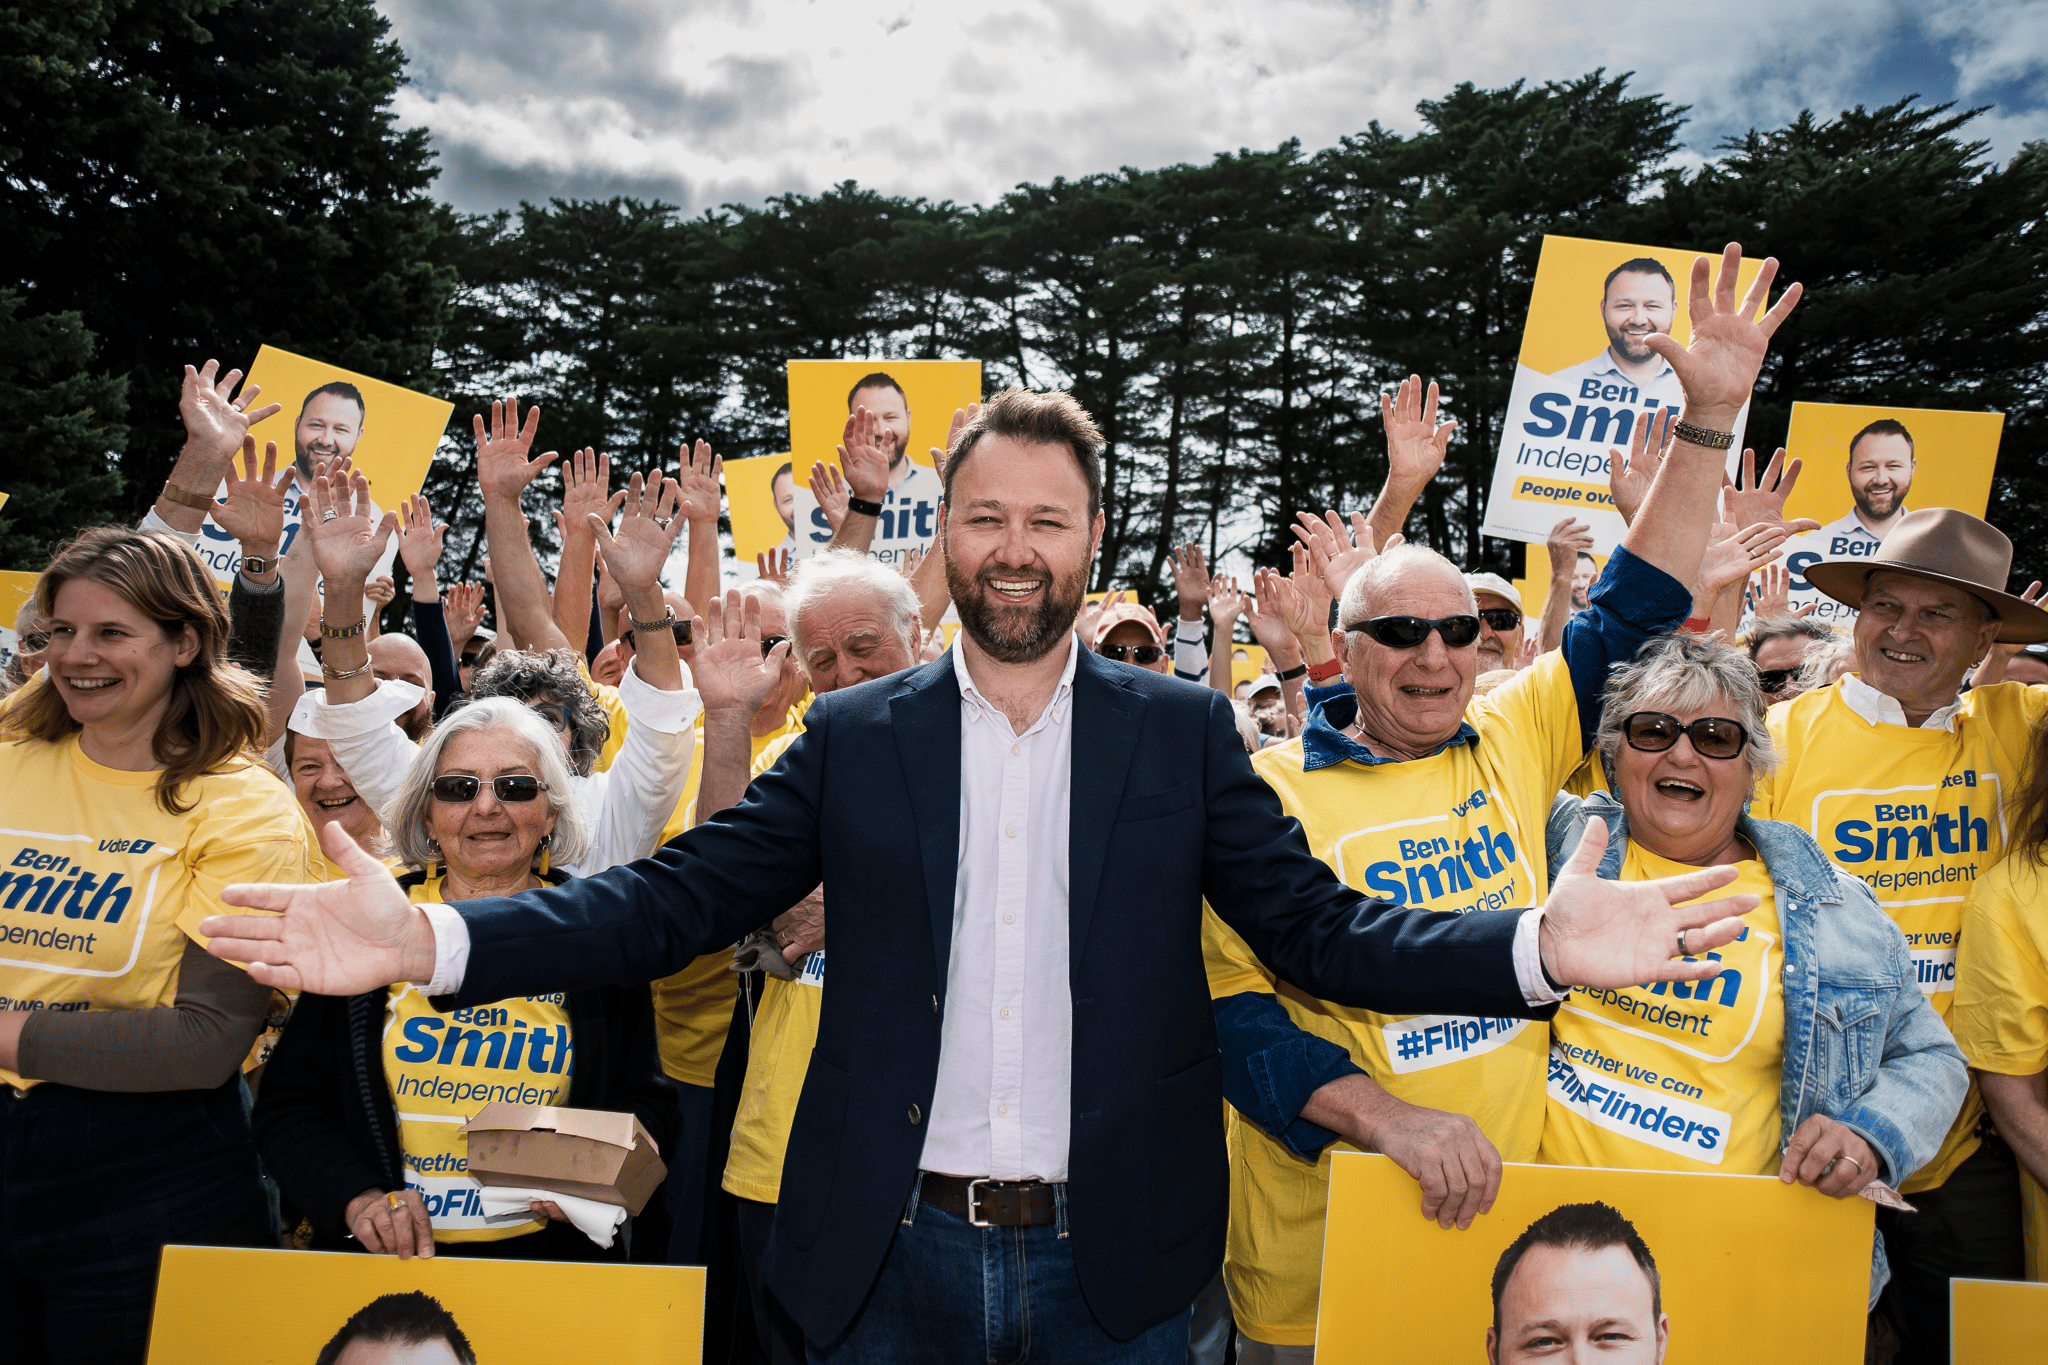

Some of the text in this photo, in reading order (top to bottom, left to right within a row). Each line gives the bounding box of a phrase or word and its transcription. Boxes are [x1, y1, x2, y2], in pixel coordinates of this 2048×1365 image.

[1579, 378, 1639, 404] Ben
[1520, 482, 1616, 506] People ove
[1829, 537, 1881, 557] Ben
[1875, 804, 1928, 822] Ben
[98, 838, 130, 853] Vote
[1399, 837, 1450, 861] Ben
[11, 848, 71, 873] Ben
[1365, 825, 1516, 906] Smith
[0, 866, 133, 924] mith
[1925, 932, 1952, 945] we
[453, 1007, 508, 1027] Ben
[395, 1016, 573, 1077] Smith
[1625, 1063, 1658, 1085] we
[1660, 1076, 1704, 1100] can
[402, 1148, 468, 1173] ogethe
